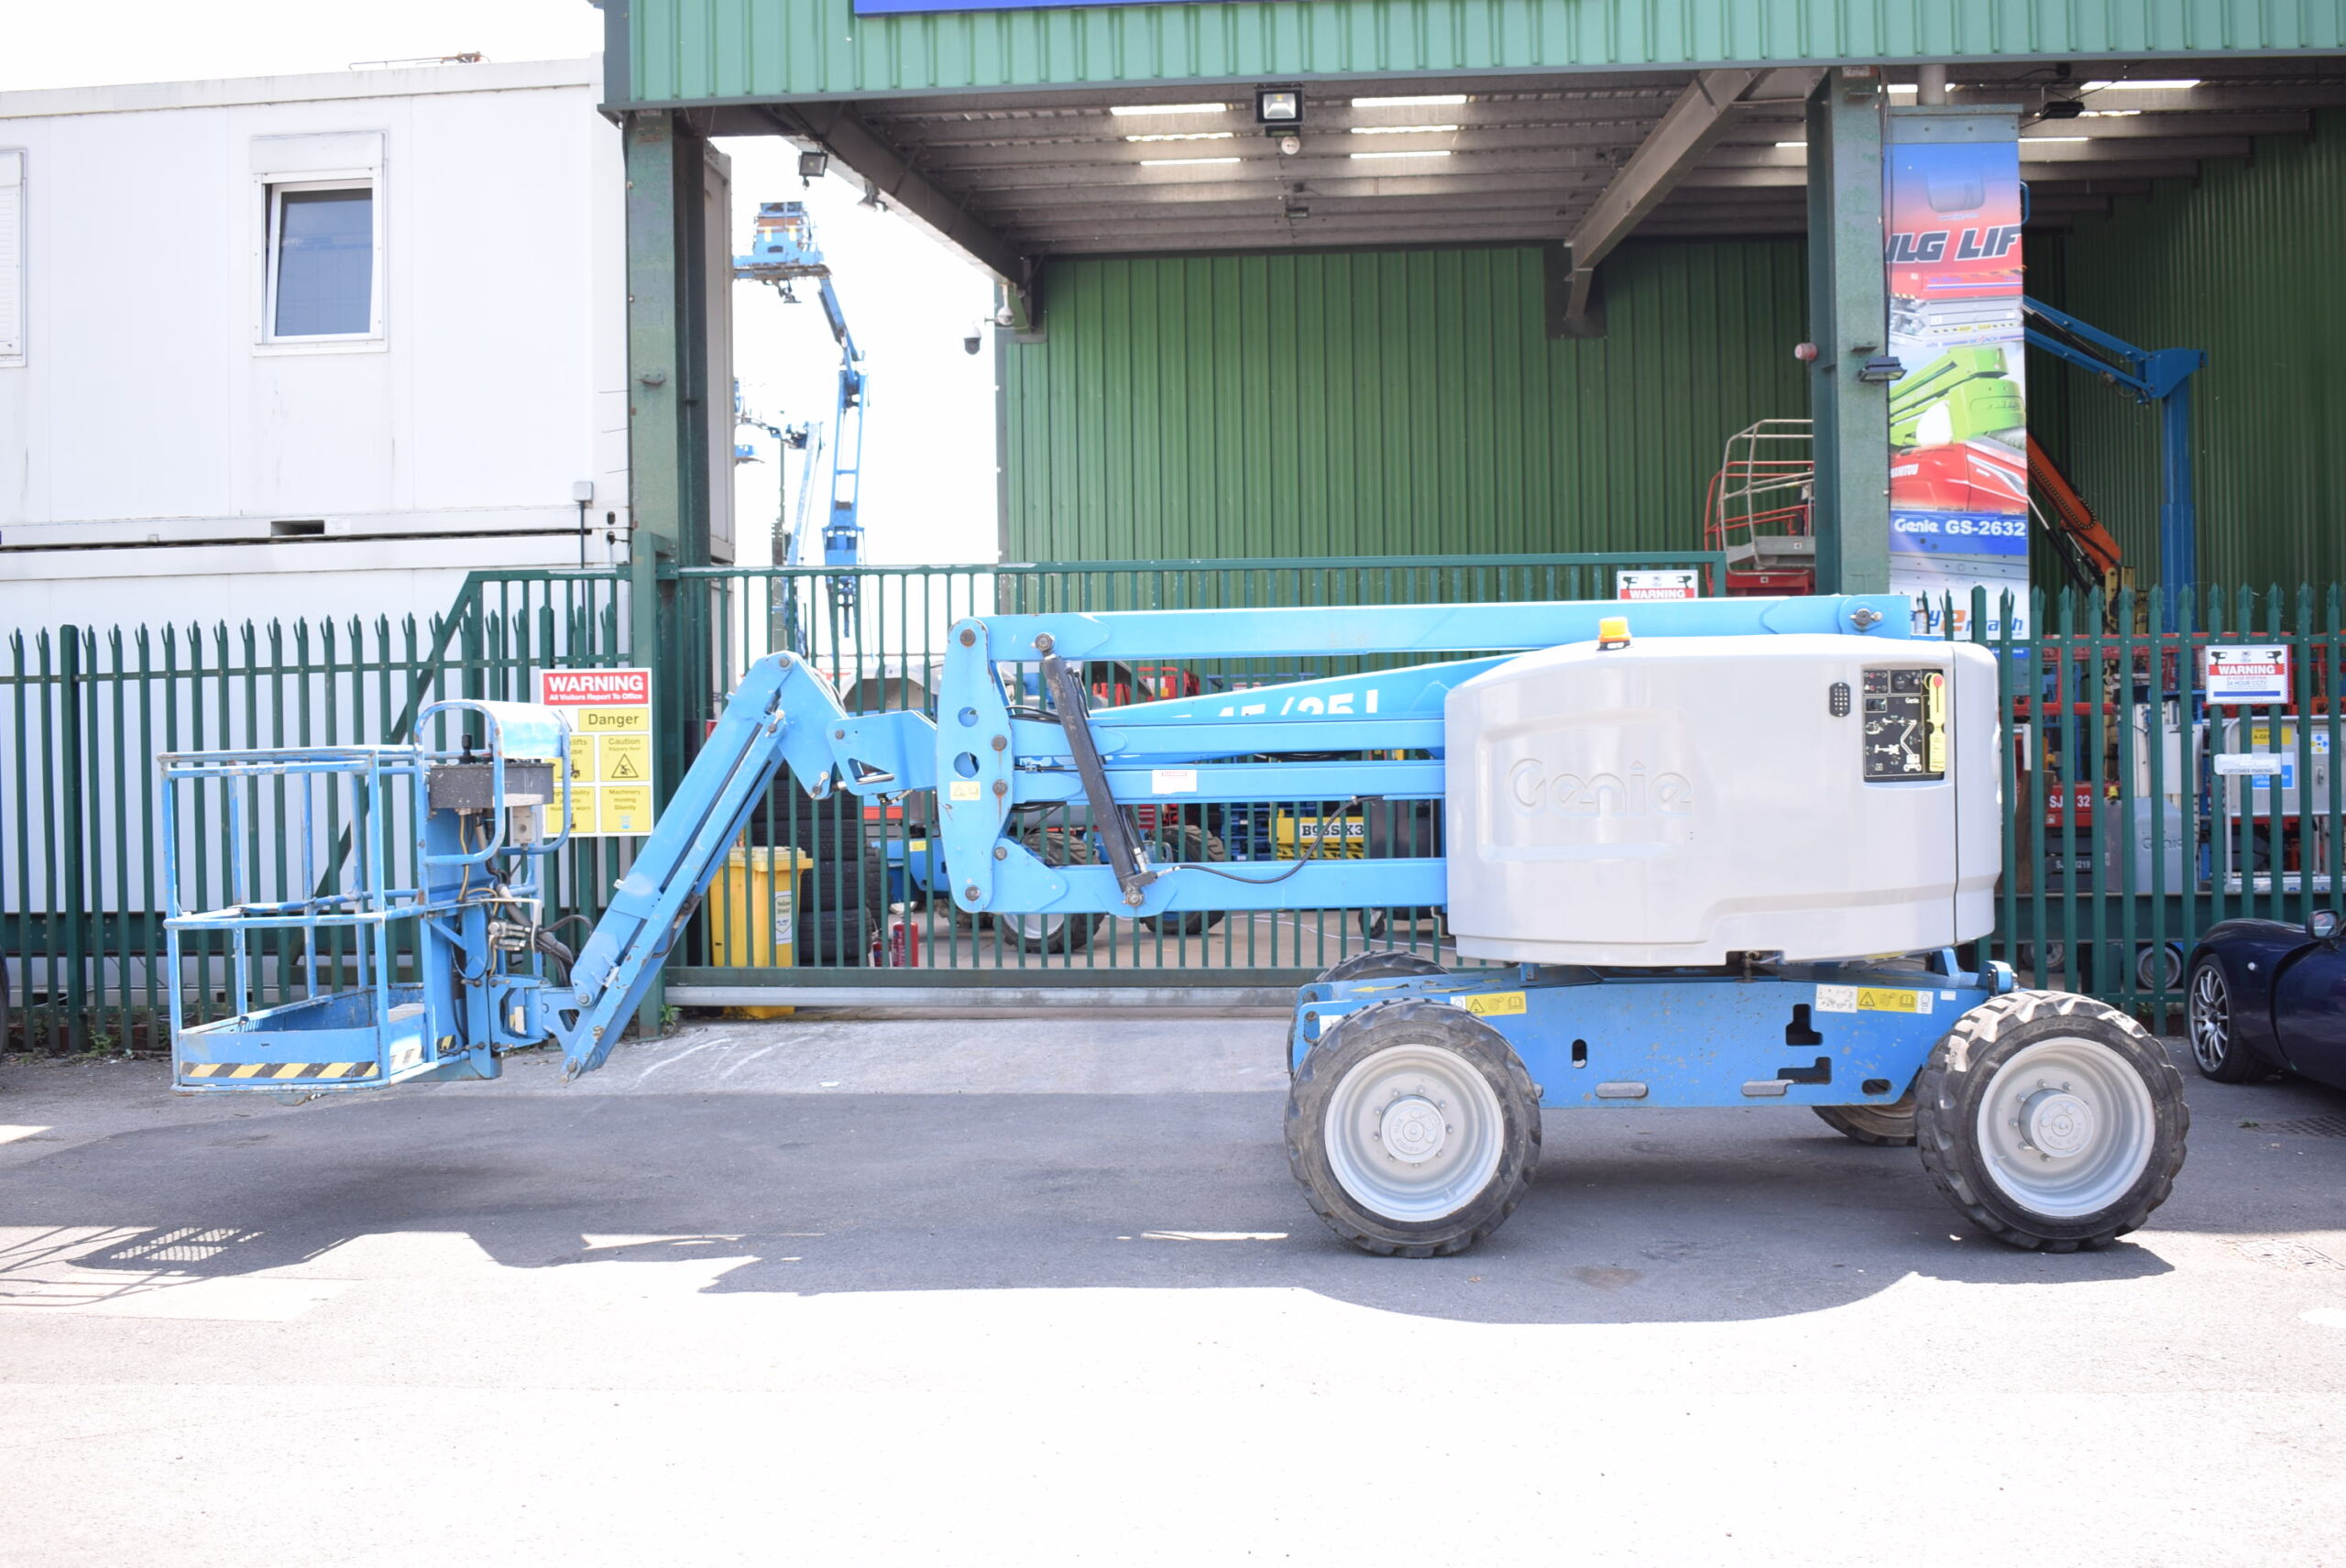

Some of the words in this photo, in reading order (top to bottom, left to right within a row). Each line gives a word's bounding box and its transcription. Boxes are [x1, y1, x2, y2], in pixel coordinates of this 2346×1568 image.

[1886, 229, 1950, 264] JLG
[1894, 518, 1940, 532] Genie
[1945, 521, 2026, 536] GS-2632
[1630, 588, 1686, 599] WARNING
[2219, 664, 2275, 674] WARNING
[548, 674, 644, 692] WARNING
[586, 694, 610, 702] Report
[588, 714, 640, 728] Danger
[608, 737, 641, 745] Caution
[1504, 757, 1694, 817] Genie
